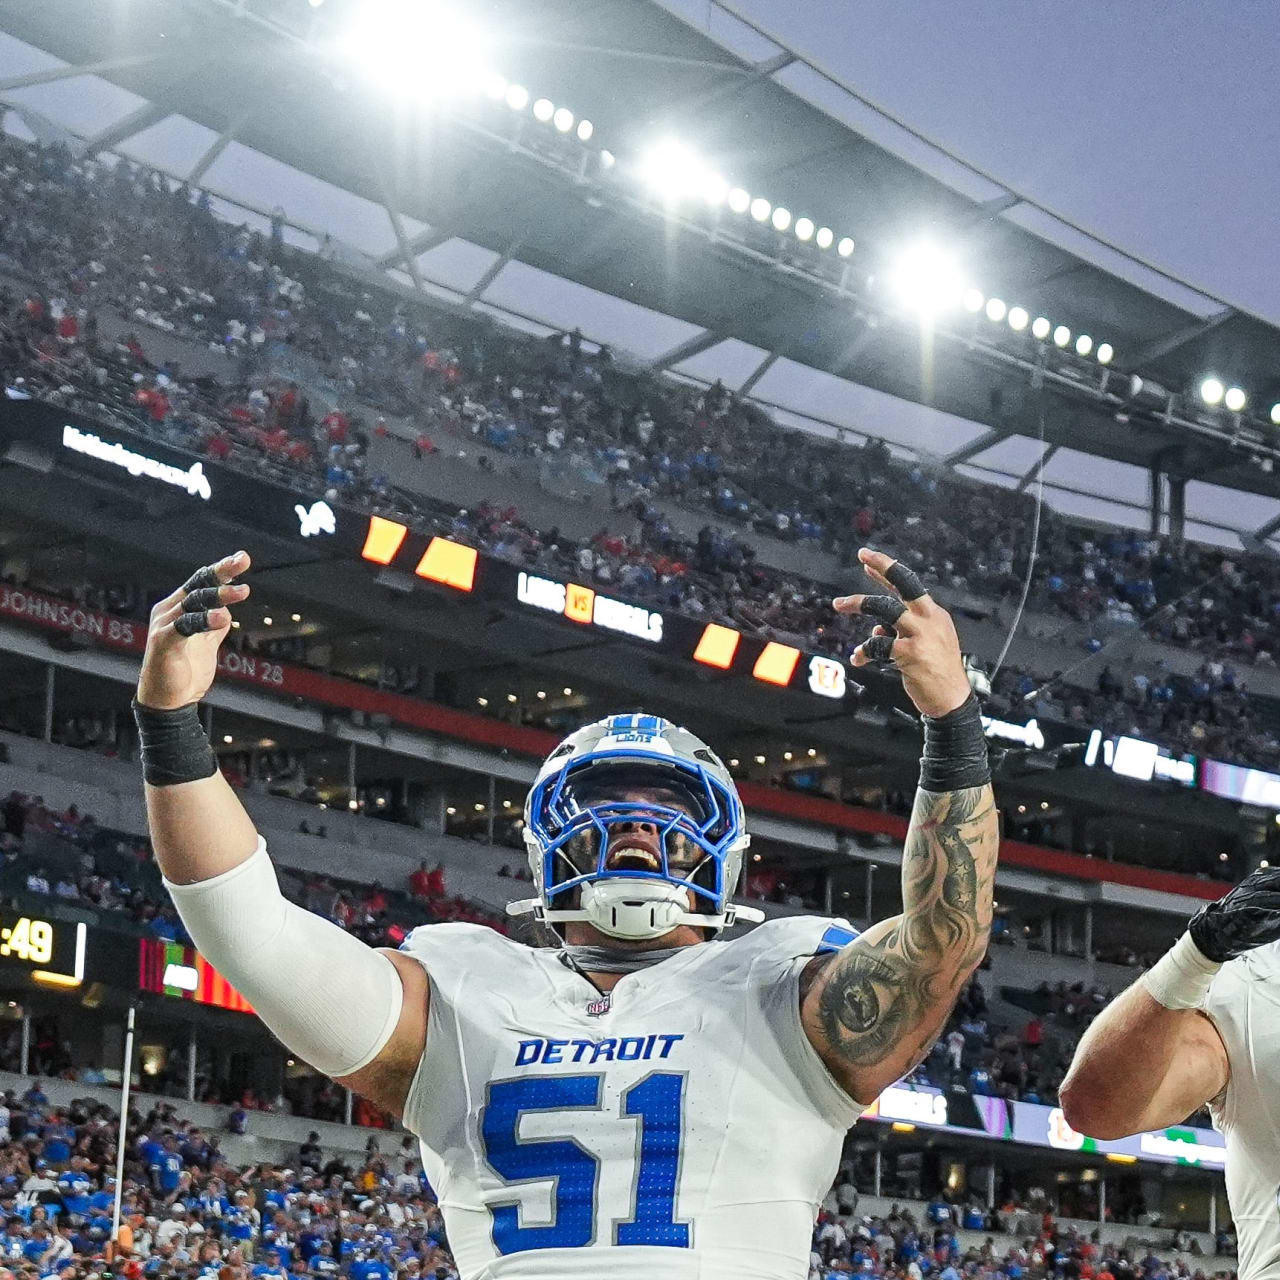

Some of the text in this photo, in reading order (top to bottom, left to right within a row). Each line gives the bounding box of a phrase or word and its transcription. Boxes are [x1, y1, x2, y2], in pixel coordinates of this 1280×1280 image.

[1, 589, 134, 643] JOHNSON 85
[261, 661, 285, 684] 28
[514, 1034, 685, 1067] DETROIT
[478, 1069, 694, 1257] 51
